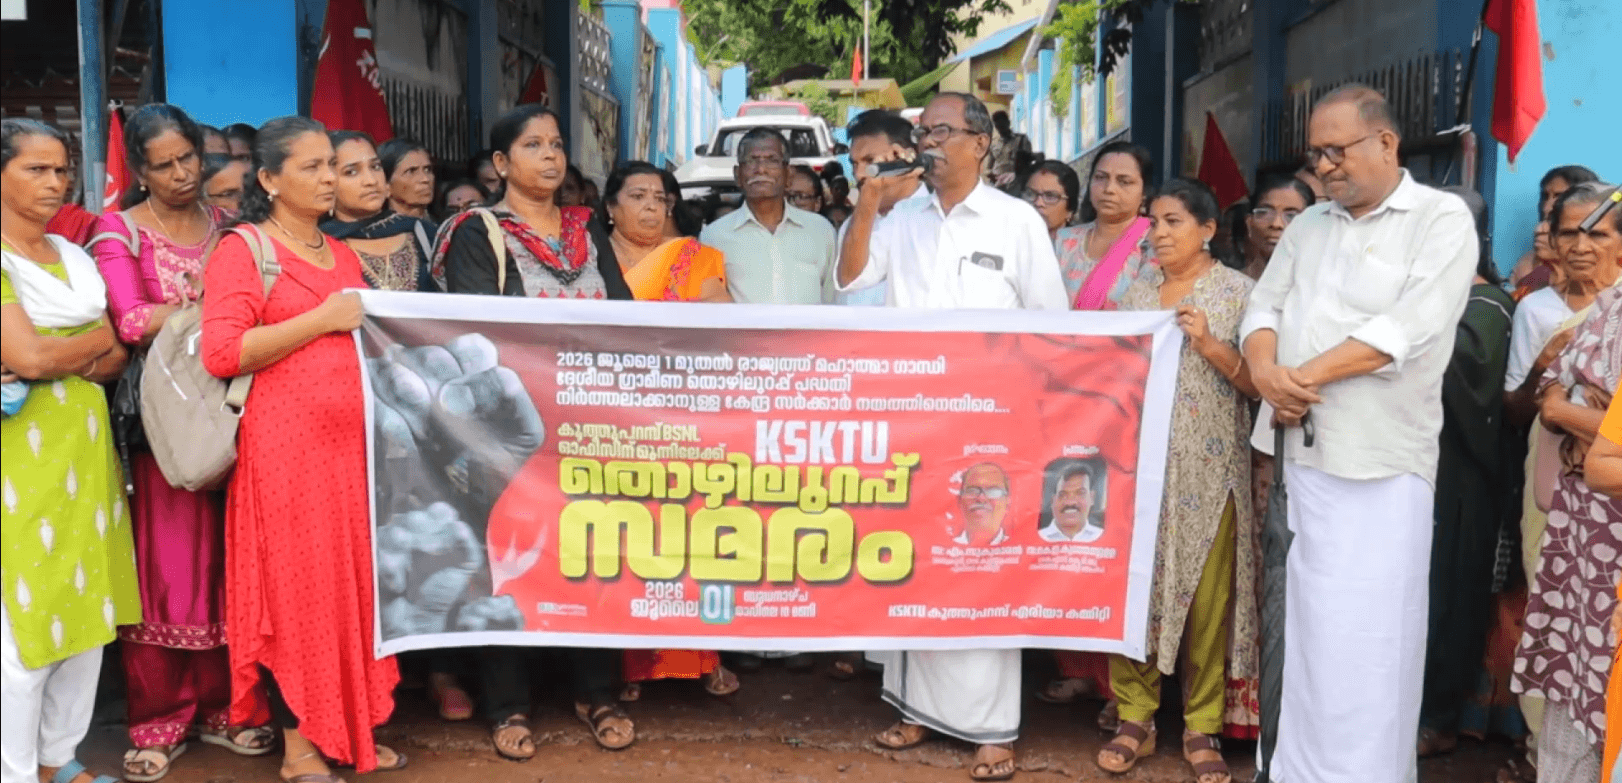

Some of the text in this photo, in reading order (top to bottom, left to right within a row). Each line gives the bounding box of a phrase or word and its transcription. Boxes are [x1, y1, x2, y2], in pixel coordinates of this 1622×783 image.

[556, 352, 593, 367] 2026
[596, 353, 661, 371] ജൂലൈ
[664, 355, 671, 369] 1
[675, 352, 734, 374] മുതൽ
[815, 357, 889, 373] മഹാത്മാ
[893, 355, 946, 374] ഗാന്ധി
[619, 369, 683, 390] ഗ്രാമീണ
[794, 373, 851, 391] പദ്ധതി
[774, 392, 852, 411] സർക്കാർ
[663, 424, 701, 442] BSNL
[755, 419, 889, 464] KSKTU
[559, 452, 920, 514] തൊഴിലുറപ്പ്
[559, 499, 914, 582] സമരം
[645, 581, 684, 599] 2026
[630, 598, 700, 620] ജൂലൈ
[703, 584, 732, 620] 01
[888, 605, 926, 617] KSKTU
